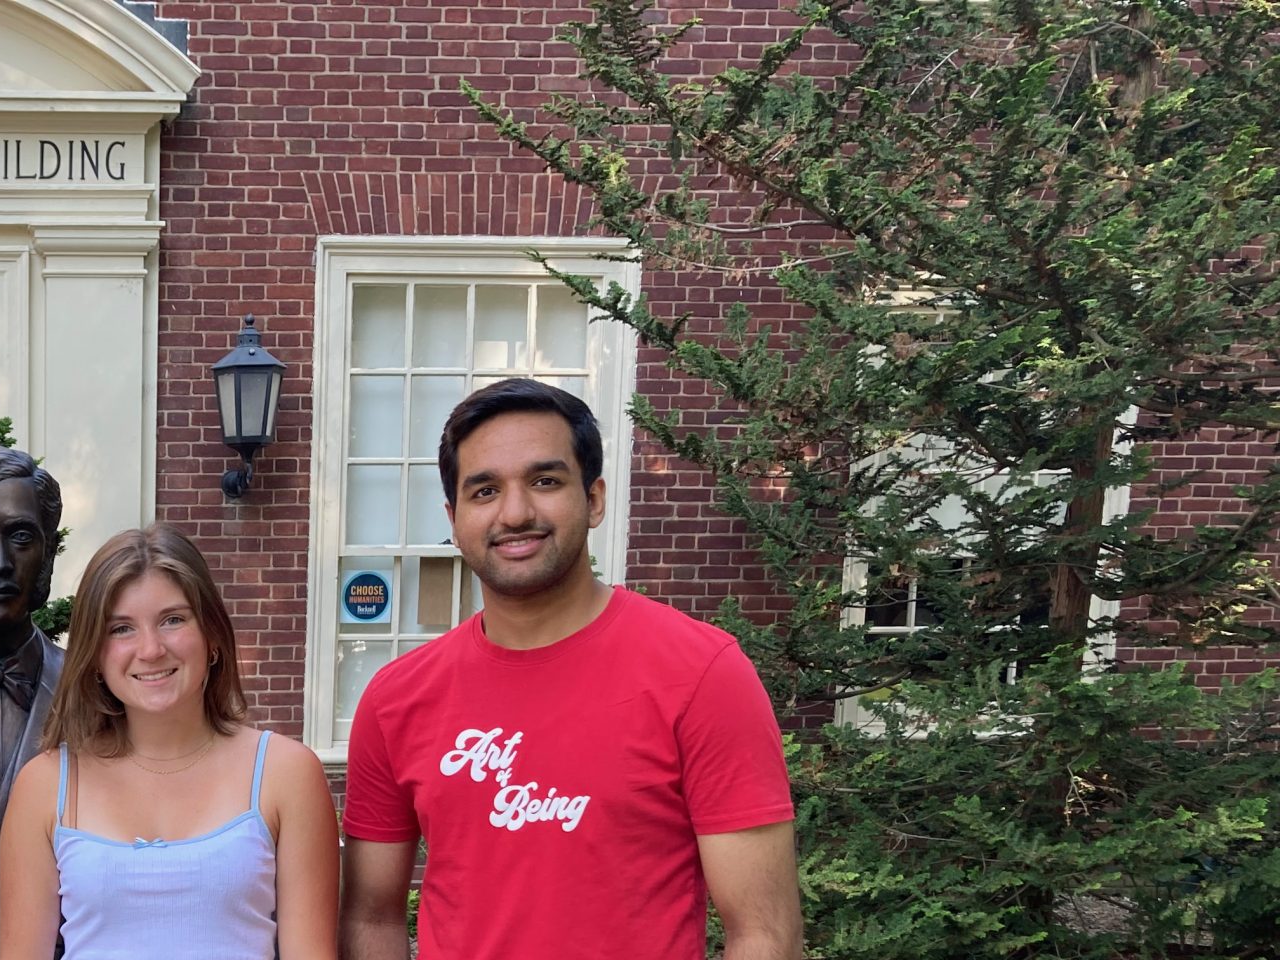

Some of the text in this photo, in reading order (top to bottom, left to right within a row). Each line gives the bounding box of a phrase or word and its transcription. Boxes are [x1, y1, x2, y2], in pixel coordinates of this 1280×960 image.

[349, 595, 385, 604] HUMANITIES
[350, 585, 384, 595] CHOOSE
[439, 727, 524, 783] Art
[495, 767, 513, 788] of
[489, 781, 591, 833] Being
